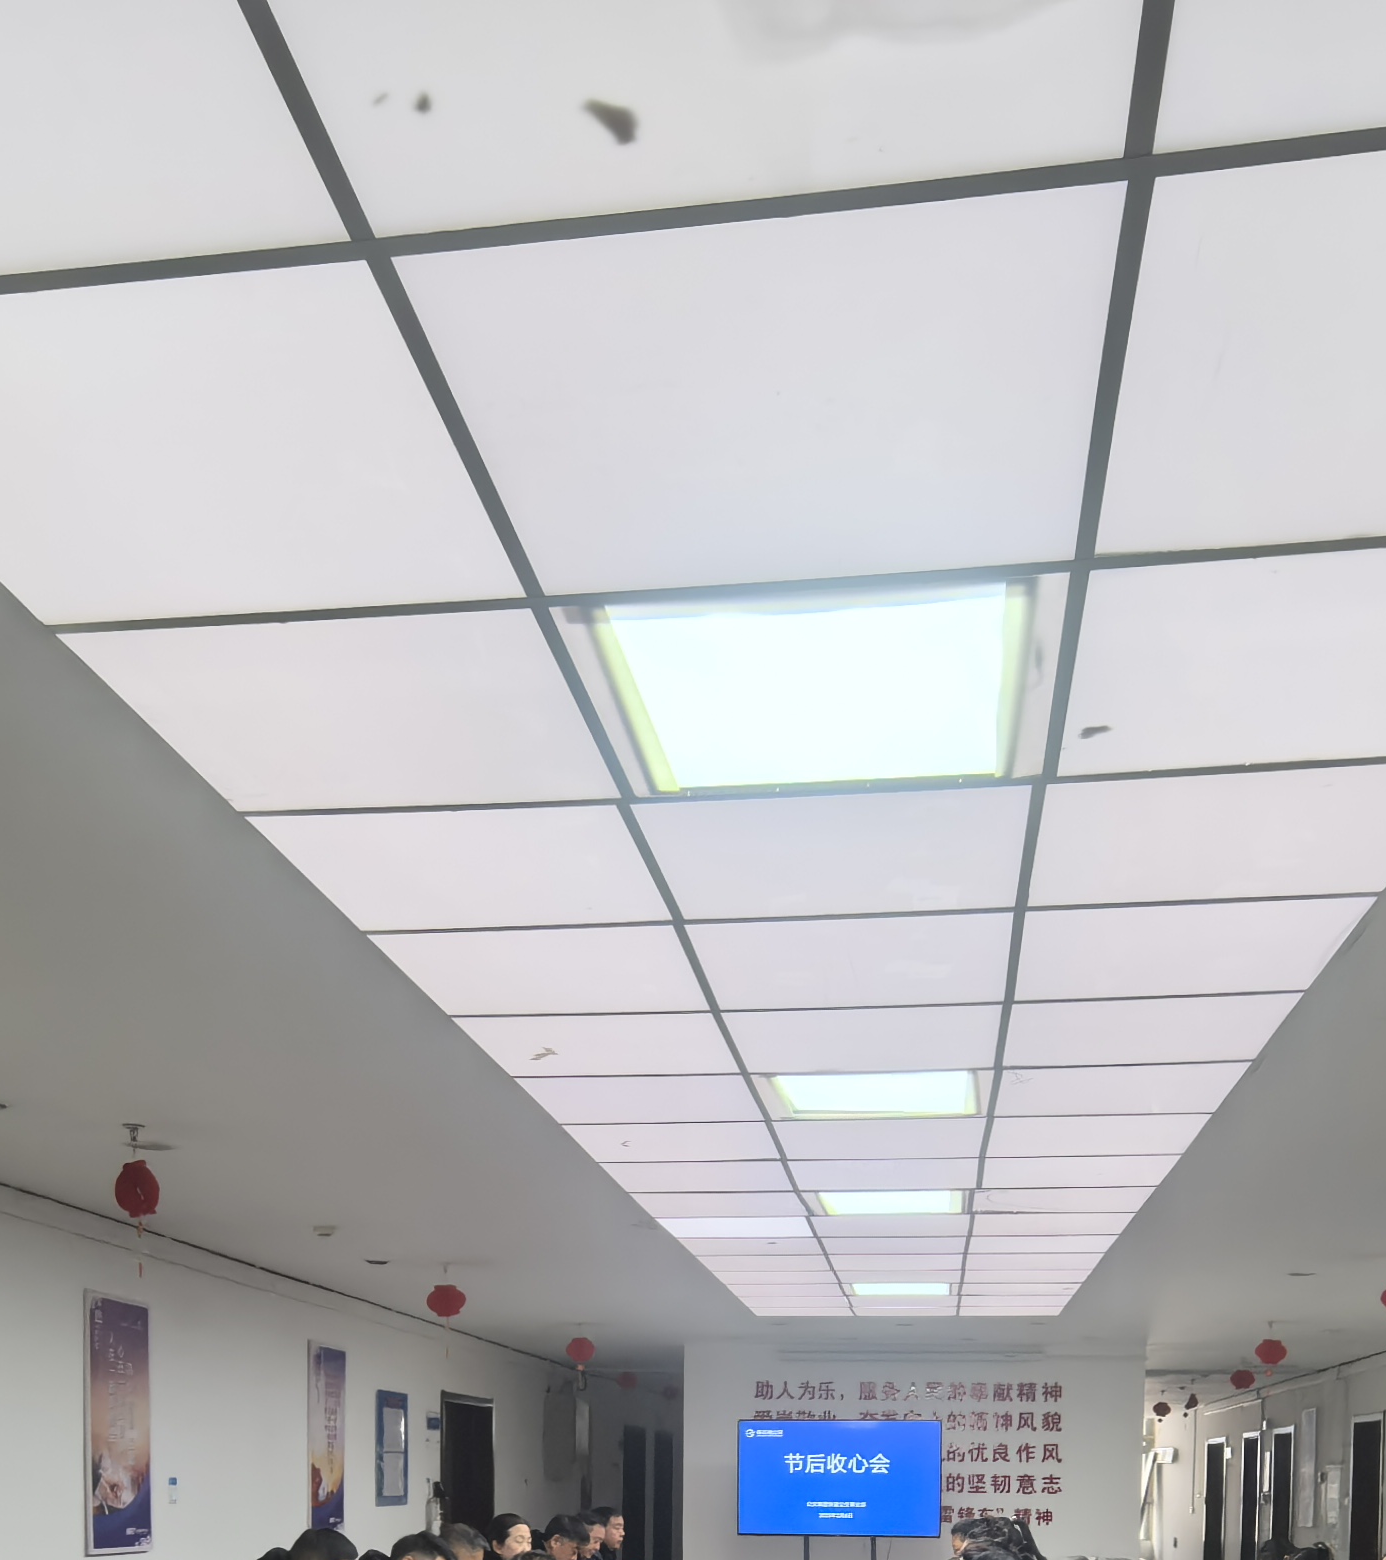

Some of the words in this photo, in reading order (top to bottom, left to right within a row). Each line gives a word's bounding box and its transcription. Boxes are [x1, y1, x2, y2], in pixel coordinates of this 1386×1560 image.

[784, 1453, 890, 1473] 节后收心会
[942, 1442, 1062, 1463] 的优良作风
[942, 1473, 1062, 1494] 的坚韧意志
